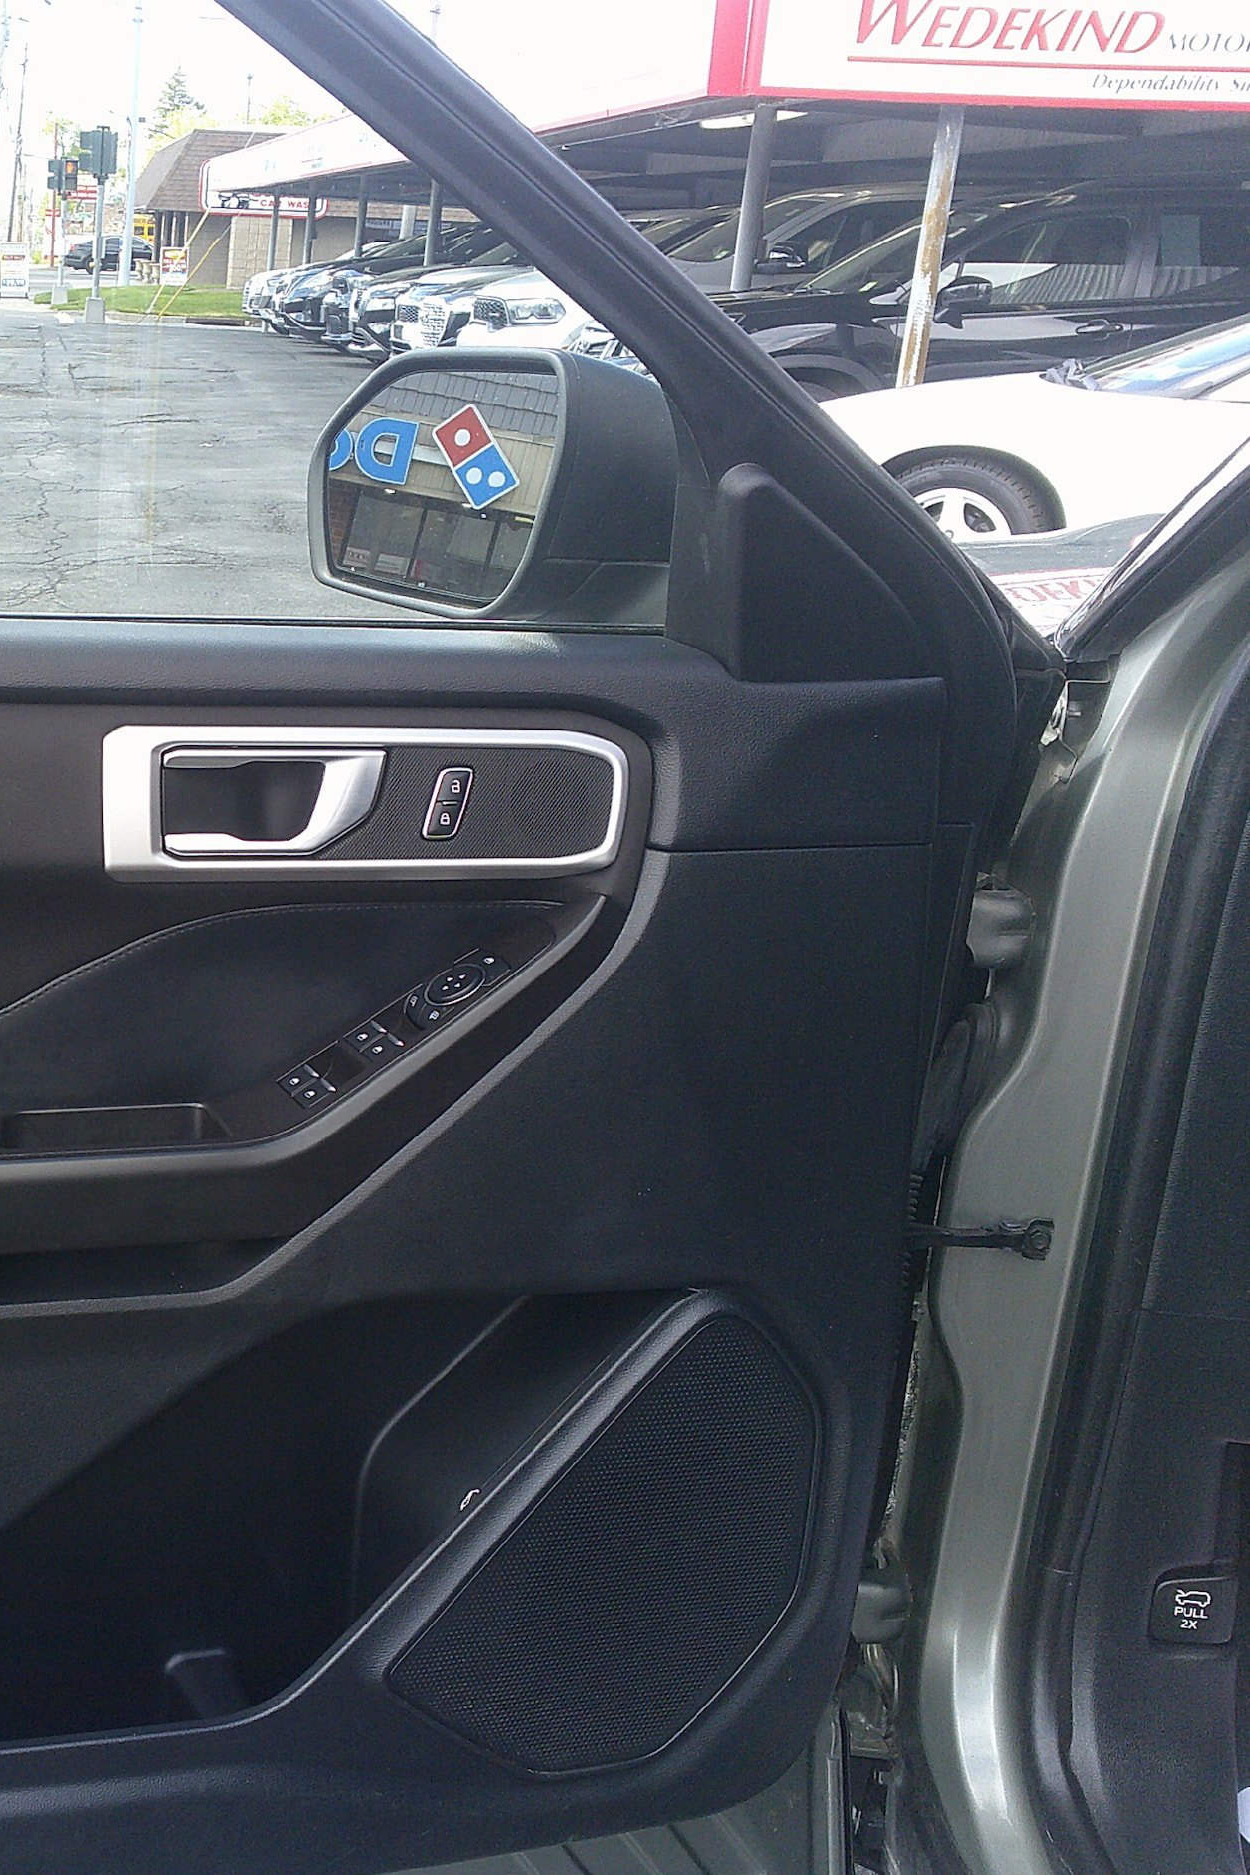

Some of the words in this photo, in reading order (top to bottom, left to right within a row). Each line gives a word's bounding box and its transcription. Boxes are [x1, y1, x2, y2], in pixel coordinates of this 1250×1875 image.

[856, 0, 1166, 53] WEDEKIND
[1167, 33, 1250, 53] MOTO
[1092, 74, 1220, 94] Dependability
[1229, 77, 1250, 93] Si
[260, 199, 281, 208] CA
[287, 200, 309, 209] WAS
[1174, 1606, 1209, 1619] PULL
[1180, 1619, 1198, 1630] 2X
